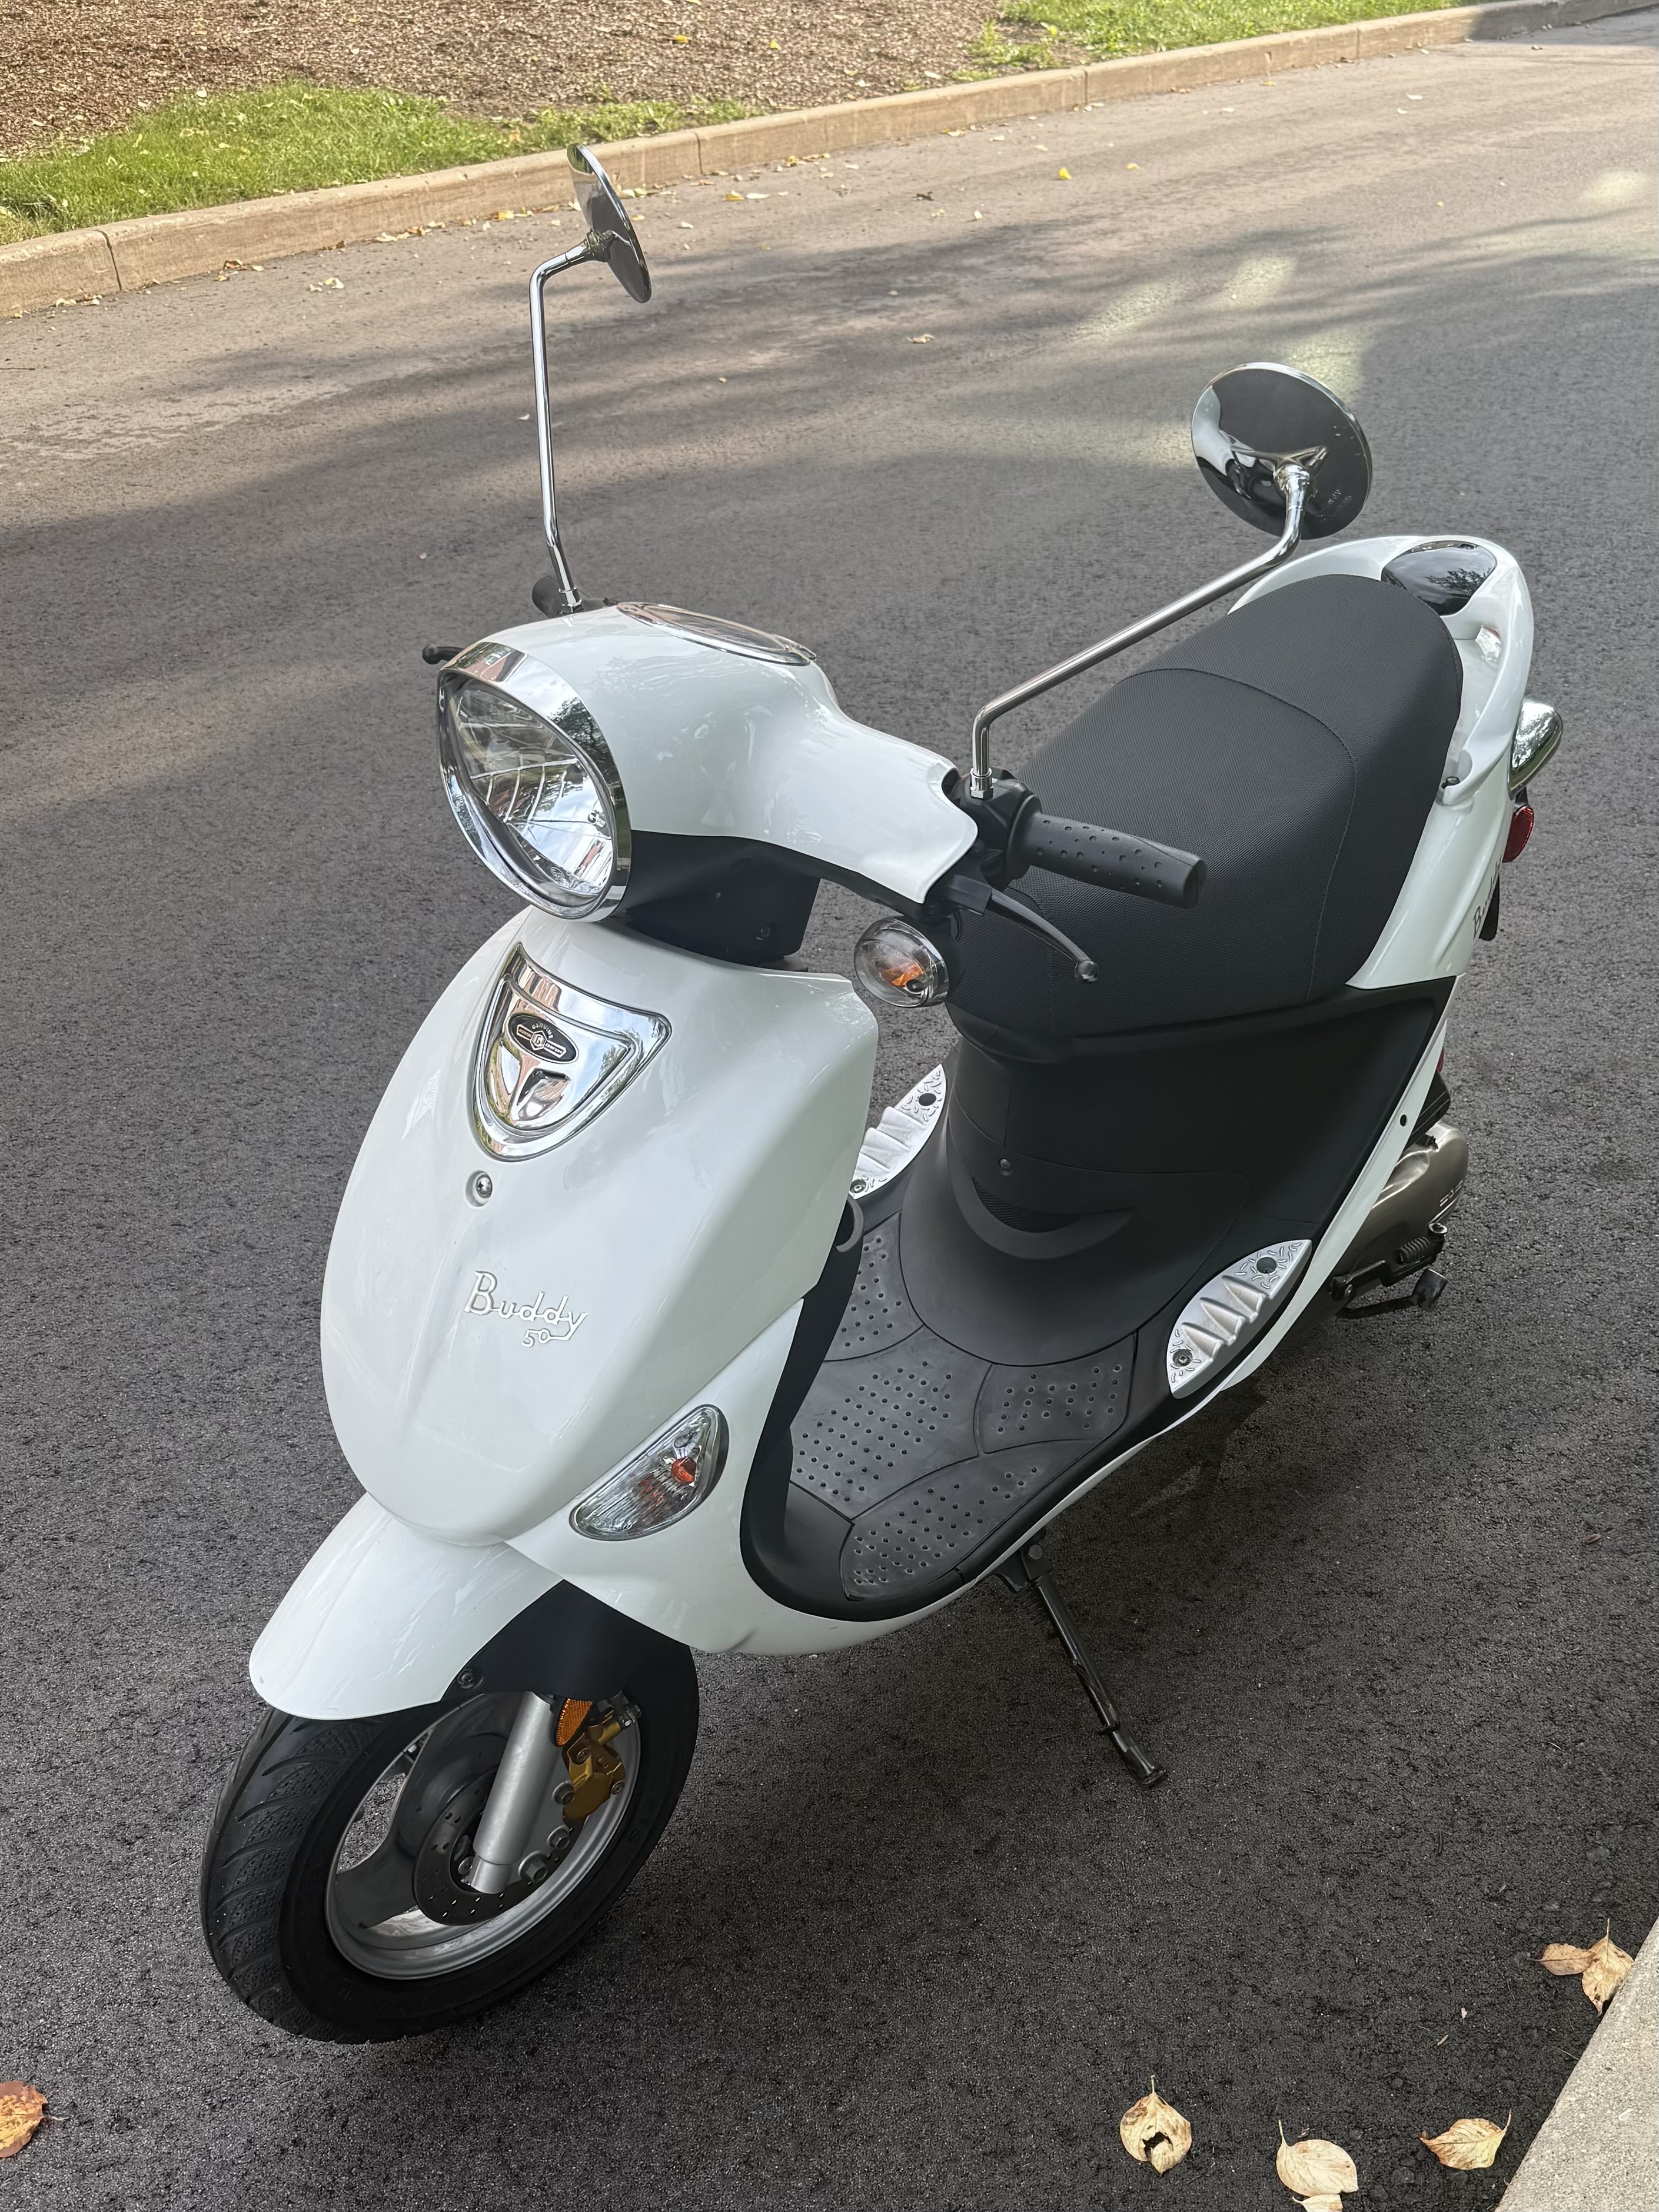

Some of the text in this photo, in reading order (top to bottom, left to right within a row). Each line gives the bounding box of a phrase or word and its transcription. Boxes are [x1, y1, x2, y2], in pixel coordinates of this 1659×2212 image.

[531, 1023, 554, 1039] GENUINE
[532, 1033, 544, 1047] G
[464, 1270, 589, 1341] Buddy
[521, 1328, 551, 1348] 50
